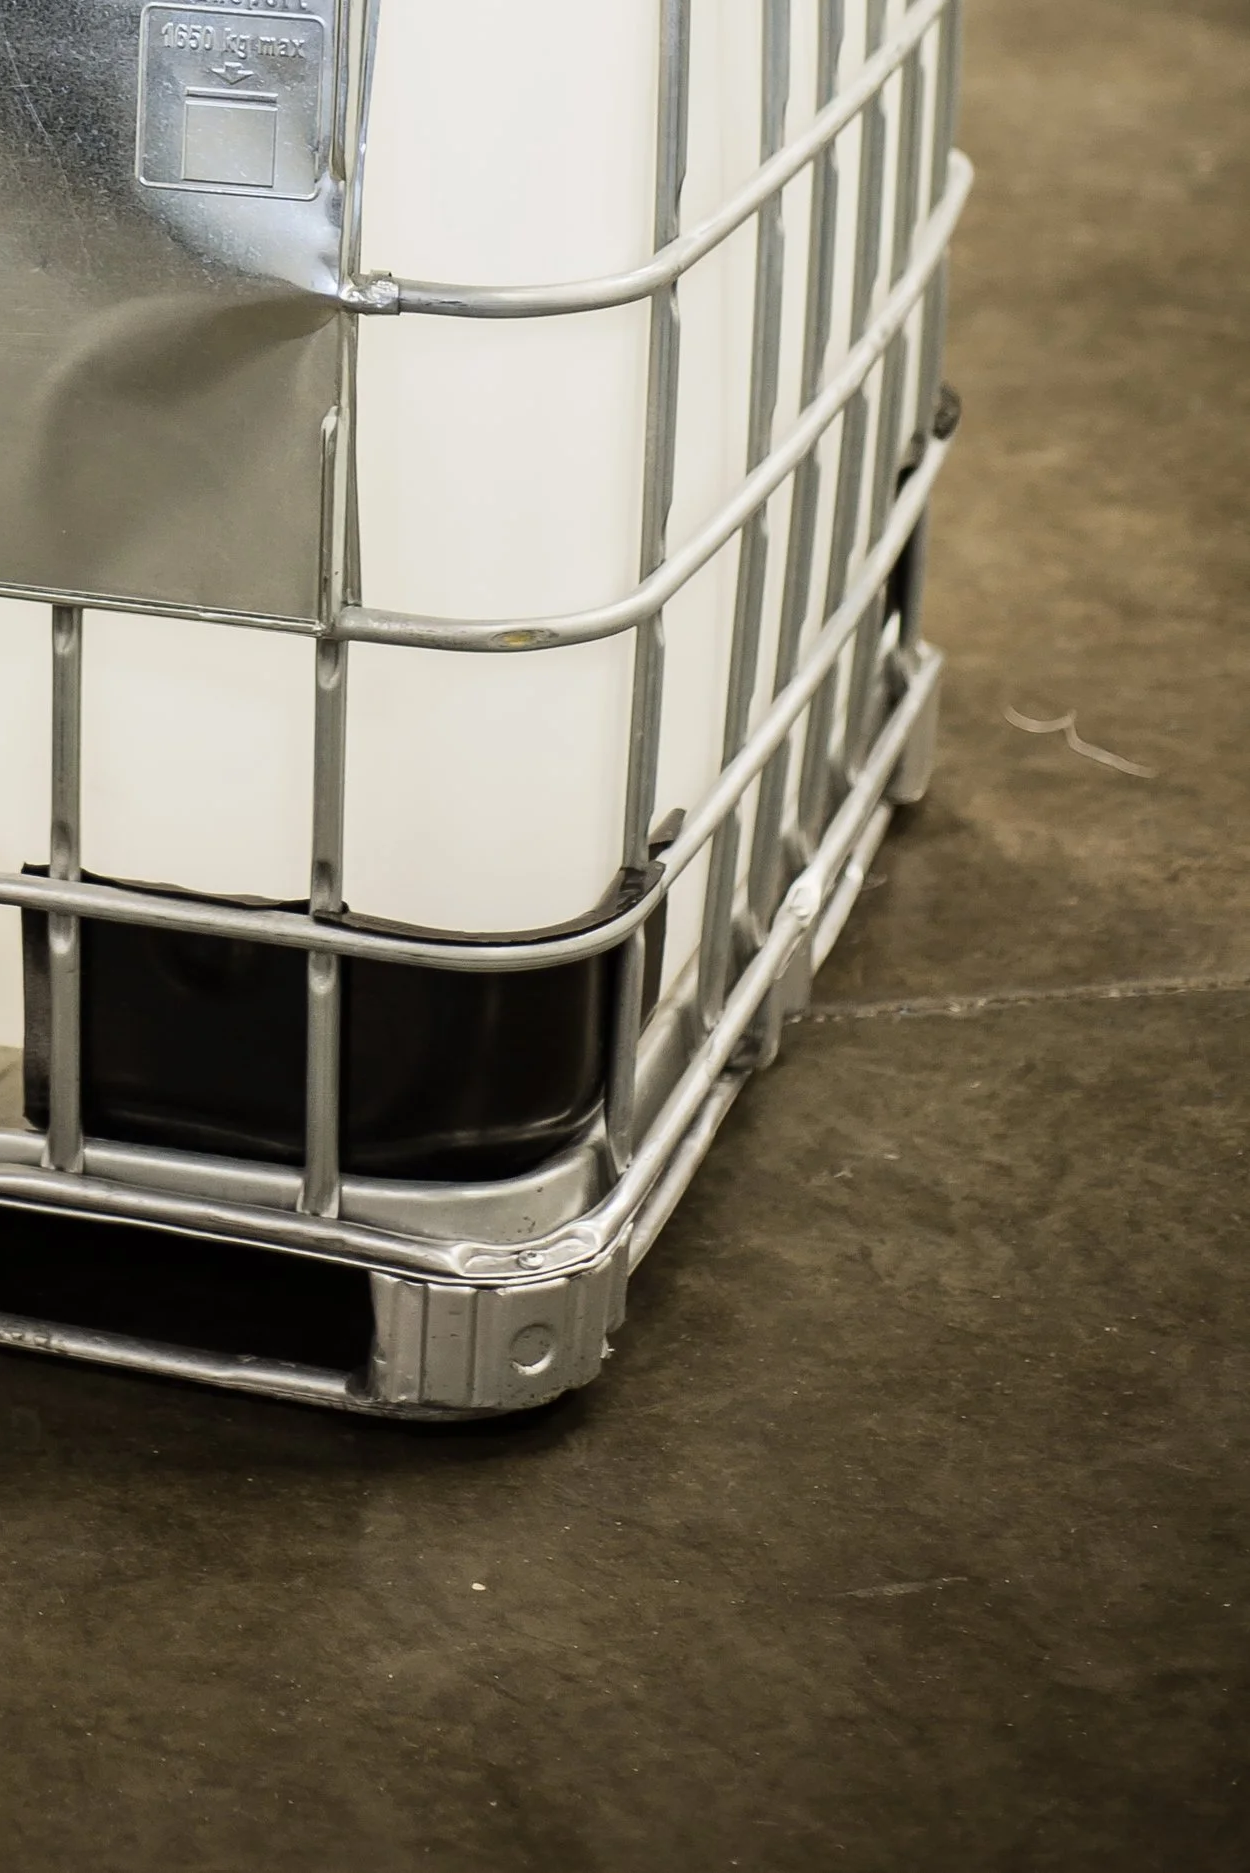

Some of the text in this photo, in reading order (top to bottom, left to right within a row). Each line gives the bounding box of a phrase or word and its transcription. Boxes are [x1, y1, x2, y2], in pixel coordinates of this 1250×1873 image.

[161, 22, 307, 59] 1650 kg max
